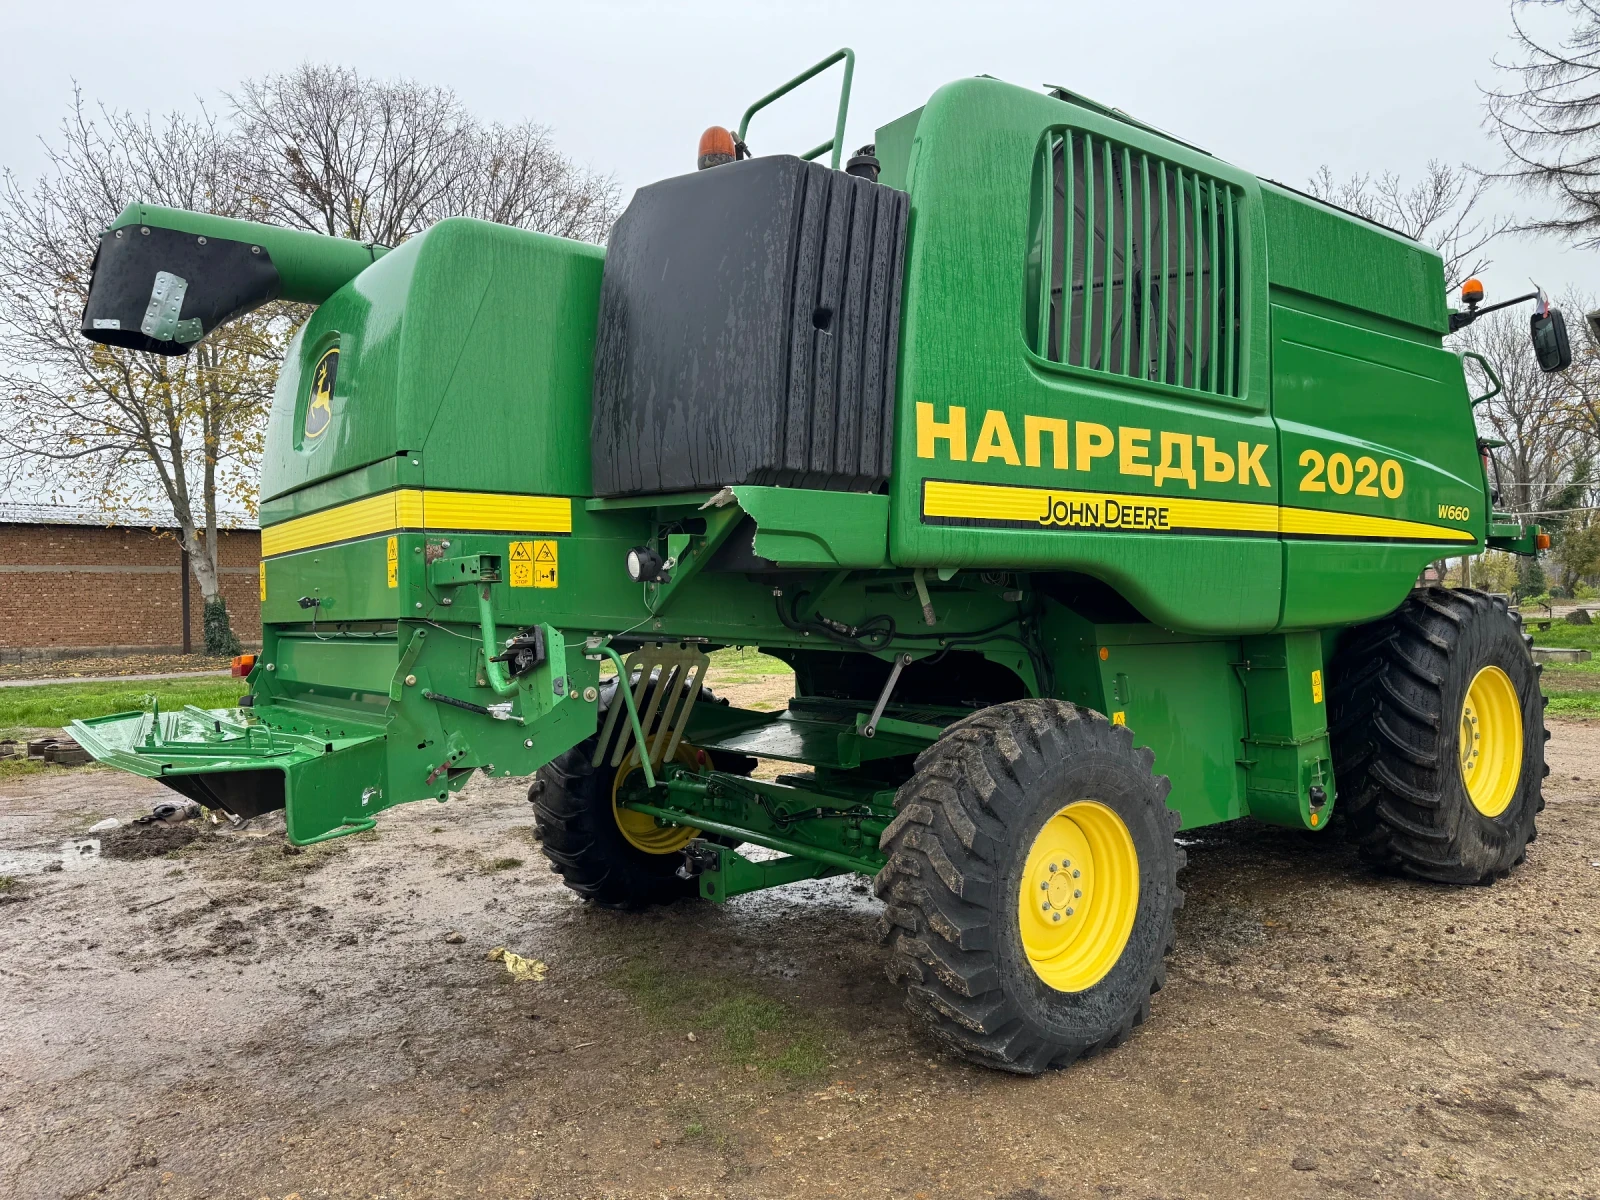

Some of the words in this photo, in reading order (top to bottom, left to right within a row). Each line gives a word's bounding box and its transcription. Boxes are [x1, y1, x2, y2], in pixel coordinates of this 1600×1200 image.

[915, 401, 1272, 490] НАПРЕДЪК
[1298, 449, 1404, 499] 2020
[1039, 495, 1099, 523] JOHN
[1104, 499, 1170, 527] DEERE
[1438, 504, 1470, 521] W660
